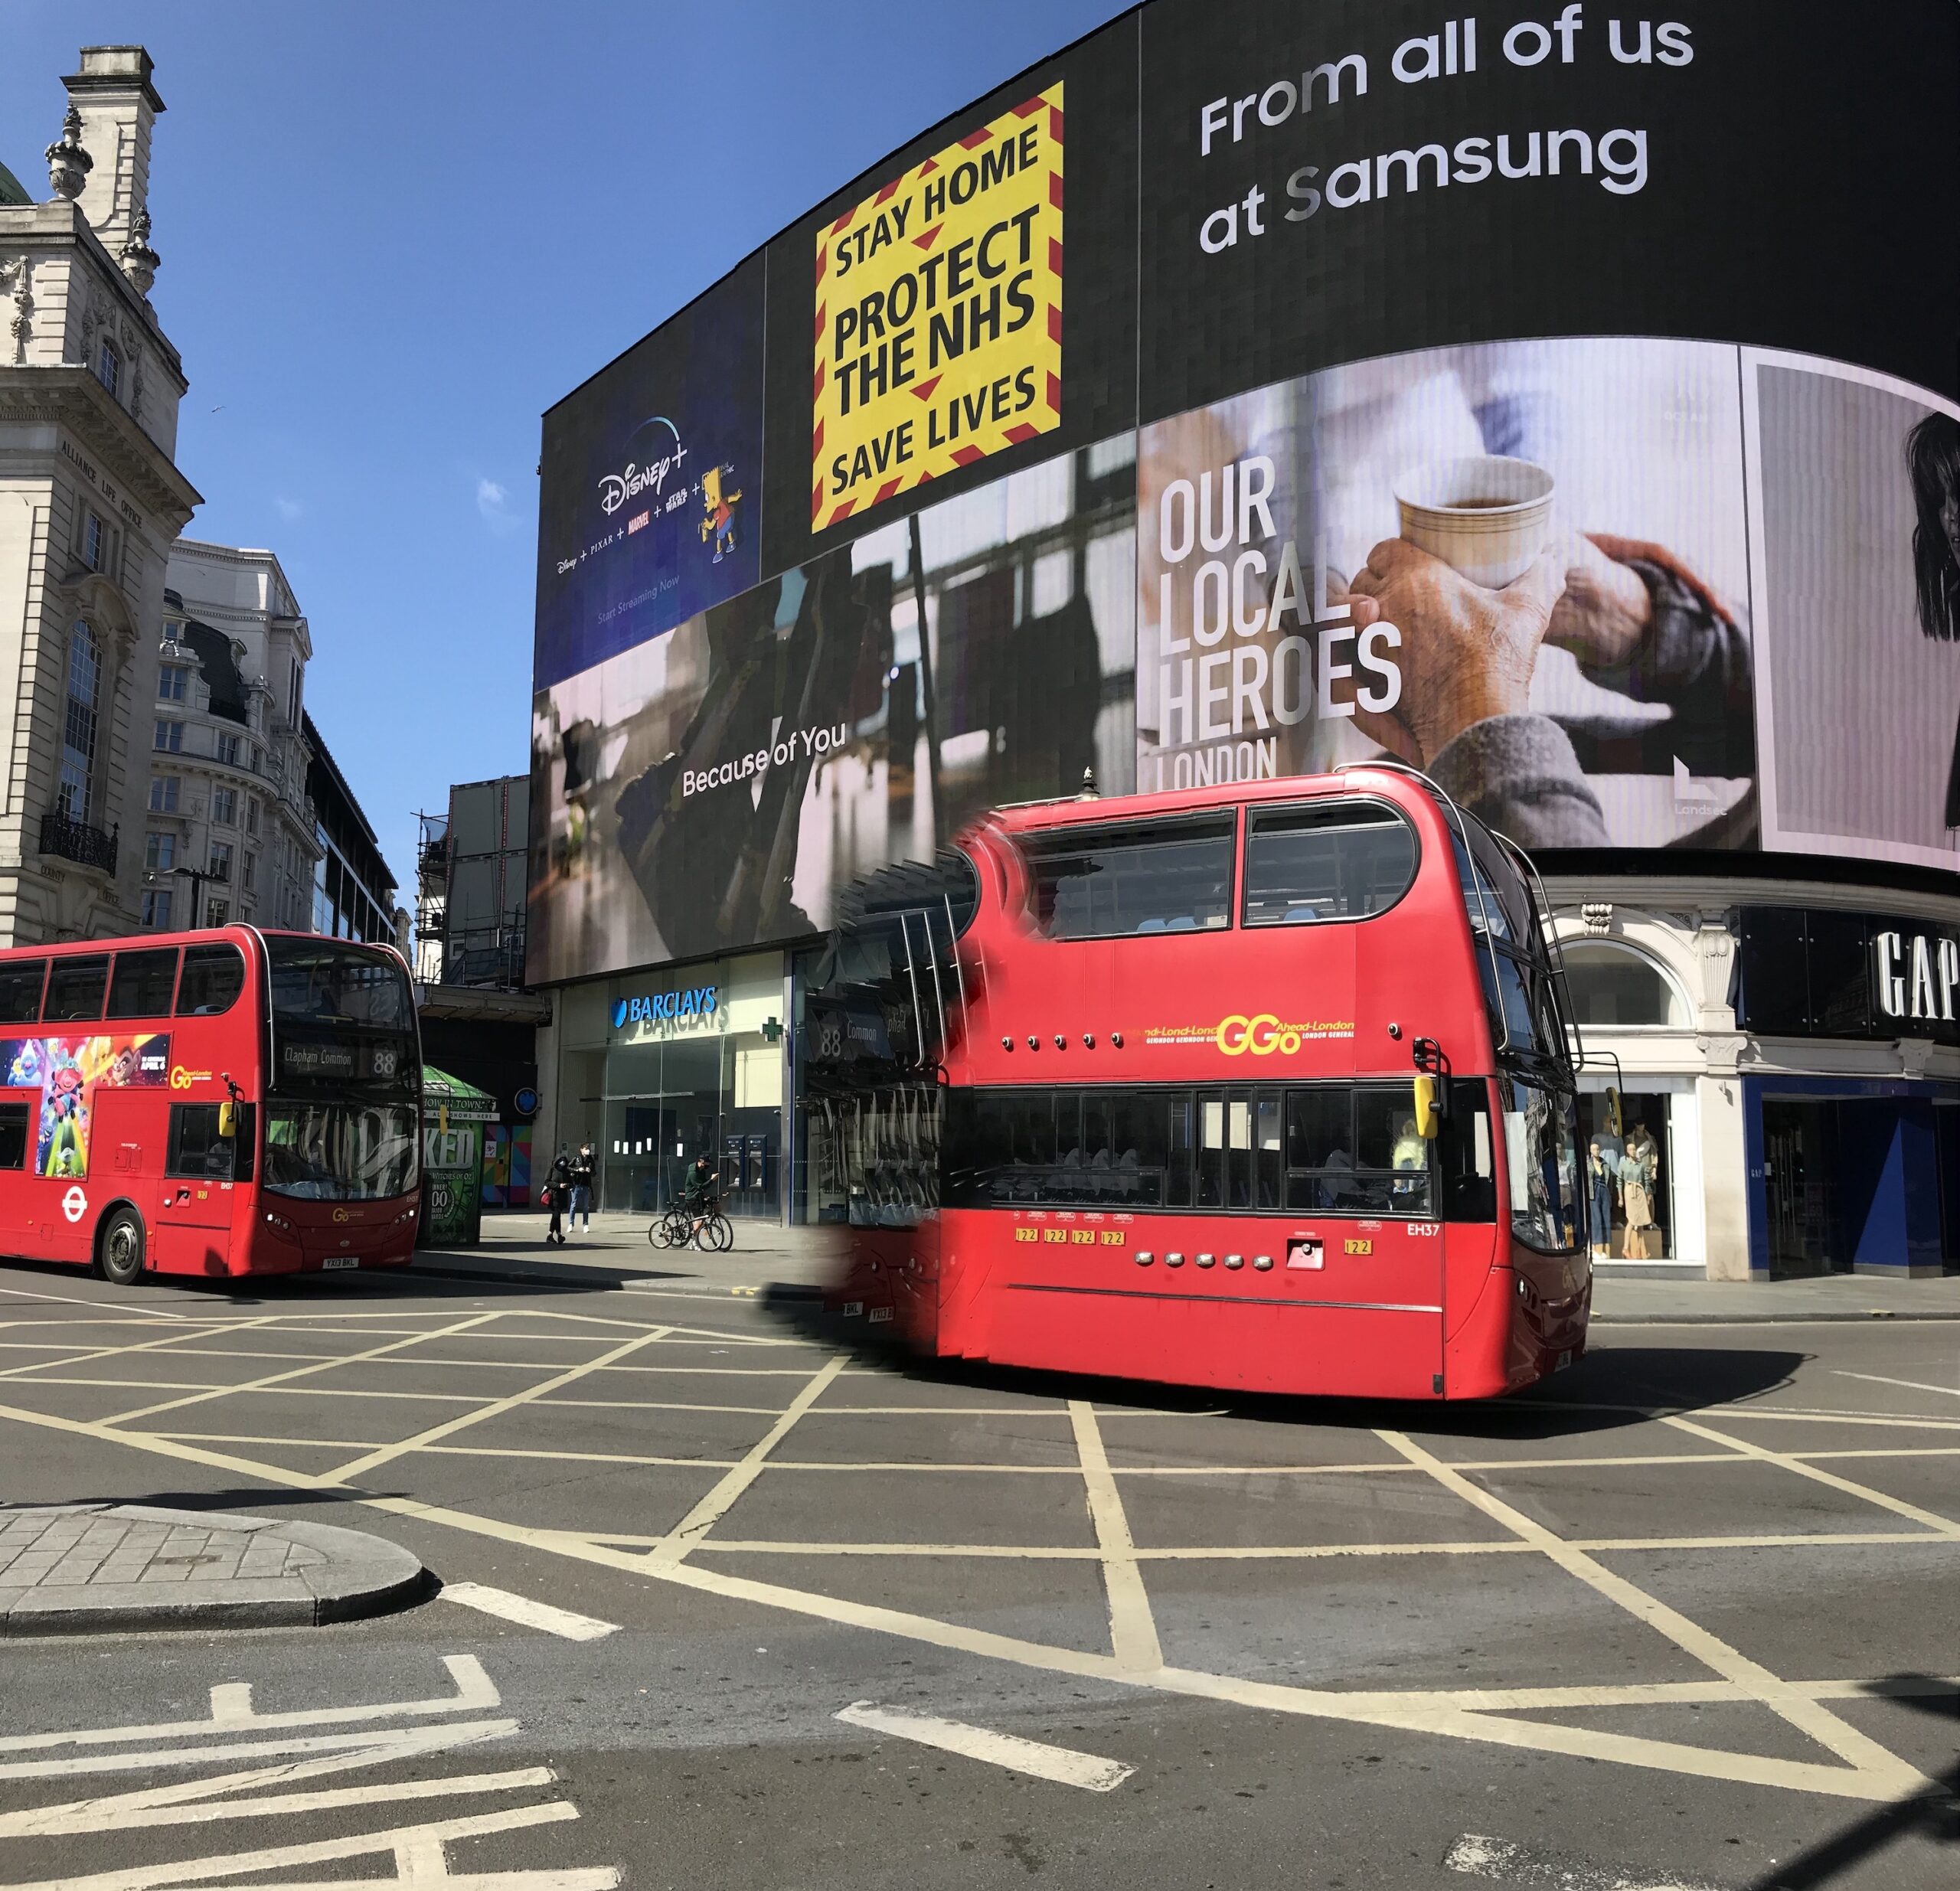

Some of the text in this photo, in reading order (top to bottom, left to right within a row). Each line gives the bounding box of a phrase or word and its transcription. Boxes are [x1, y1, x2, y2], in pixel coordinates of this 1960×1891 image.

[1200, 4, 1694, 156] From all of us
[836, 124, 1039, 277] STAY HOME
[1200, 129, 1648, 253] at Samsung
[835, 204, 1040, 362] PROTECT
[835, 269, 1035, 416] THE NHS
[832, 366, 1037, 495] SAVE LIVES
[62, 440, 143, 529] ALLIANCE LIFE OFFICE
[1160, 456, 1277, 563] OUR
[590, 534, 613, 555] PIXAR
[628, 510, 650, 536] MARVEL
[597, 575, 680, 625] Start Streaming Now
[1159, 537, 1351, 656] LOCAL
[1159, 622, 1403, 749] HEROES
[682, 722, 847, 797] Because of You
[1674, 803, 1728, 816] Landsec
[1877, 932, 1959, 1021] GAP
[629, 985, 717, 1023] BARCLAYS
[285, 1047, 352, 1066] Clapham Common
[374, 1053, 394, 1074] 88
[821, 1029, 841, 1057] 88
[171, 1065, 192, 1089] Go
[423, 1127, 475, 1169] KED
[1750, 1169, 1762, 1177] GAP
[1346, 1240, 1369, 1253] 122
[1406, 1223, 1440, 1237] EH37
[341, 1258, 355, 1267] BKL
